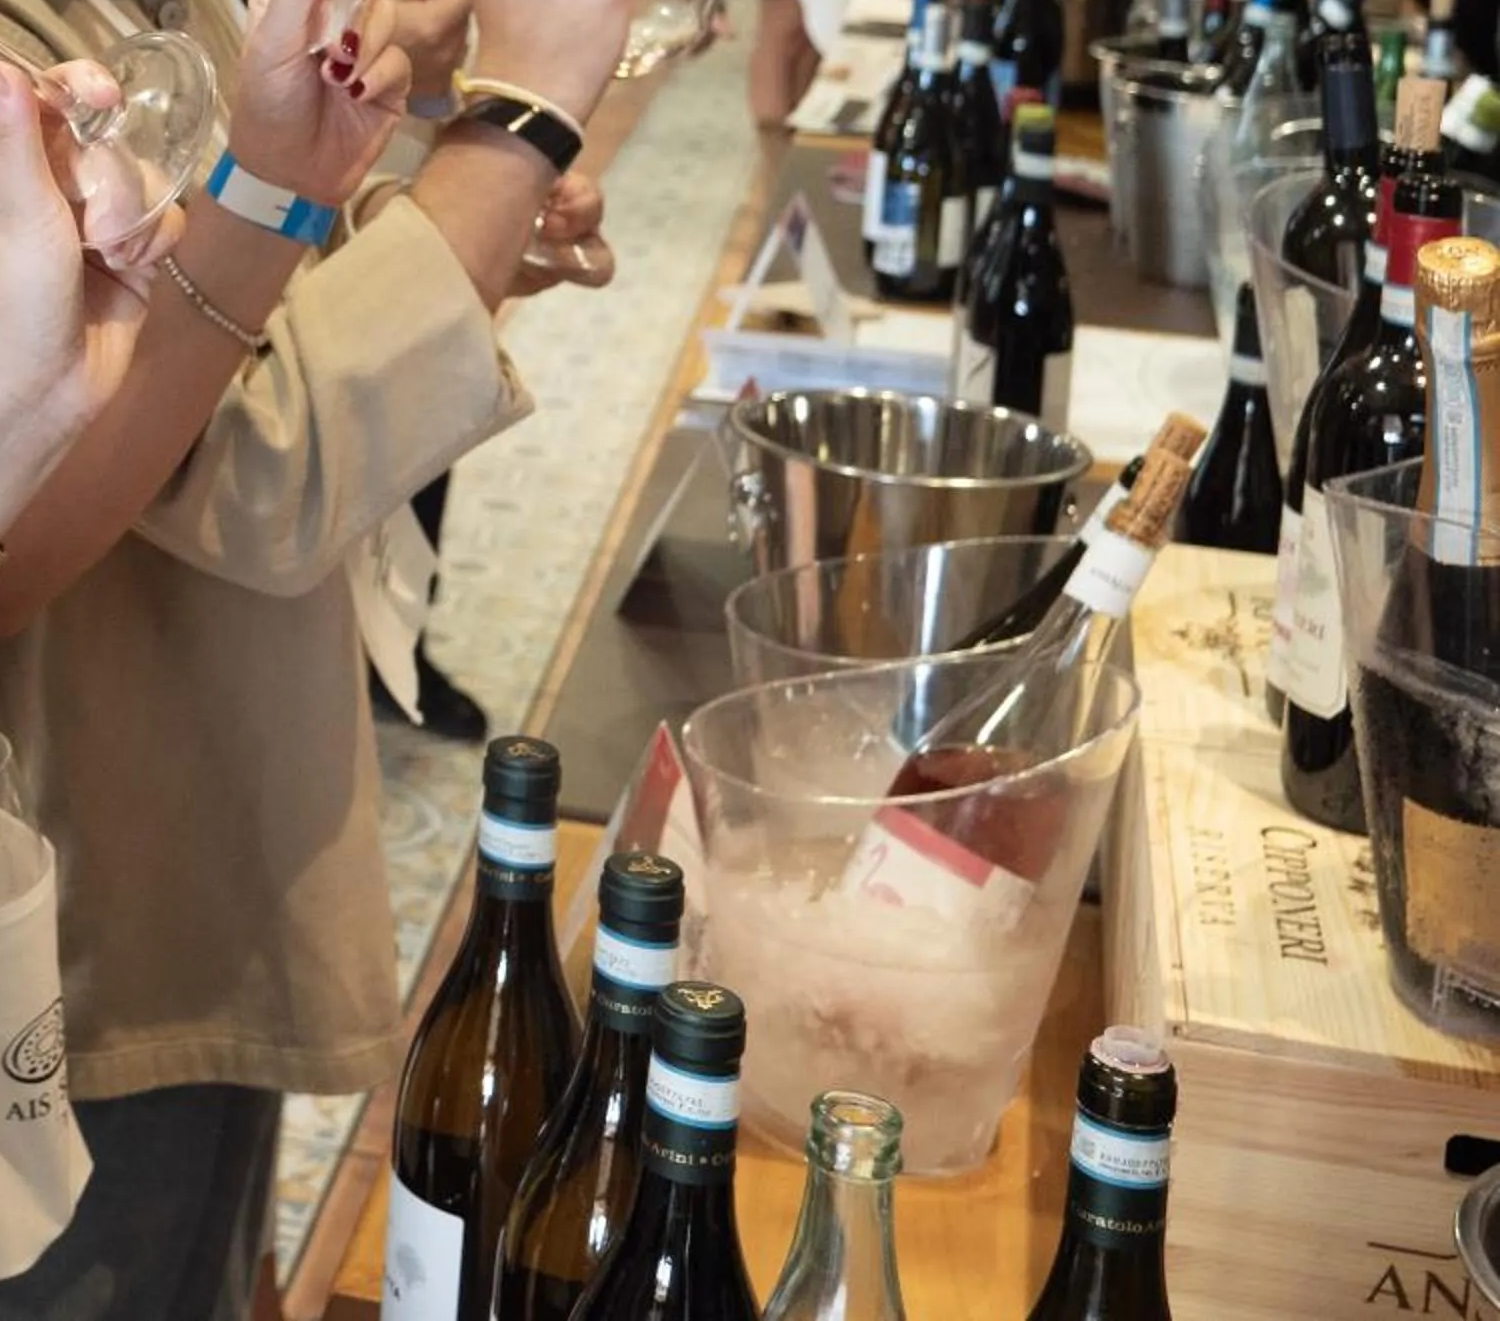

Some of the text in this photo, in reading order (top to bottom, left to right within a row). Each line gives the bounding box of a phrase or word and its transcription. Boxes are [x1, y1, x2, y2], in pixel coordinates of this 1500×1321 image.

[1260, 825, 1328, 966] CIPPONERI
[5, 1092, 51, 1121] AIS
[1365, 1263, 1483, 1321] AN
